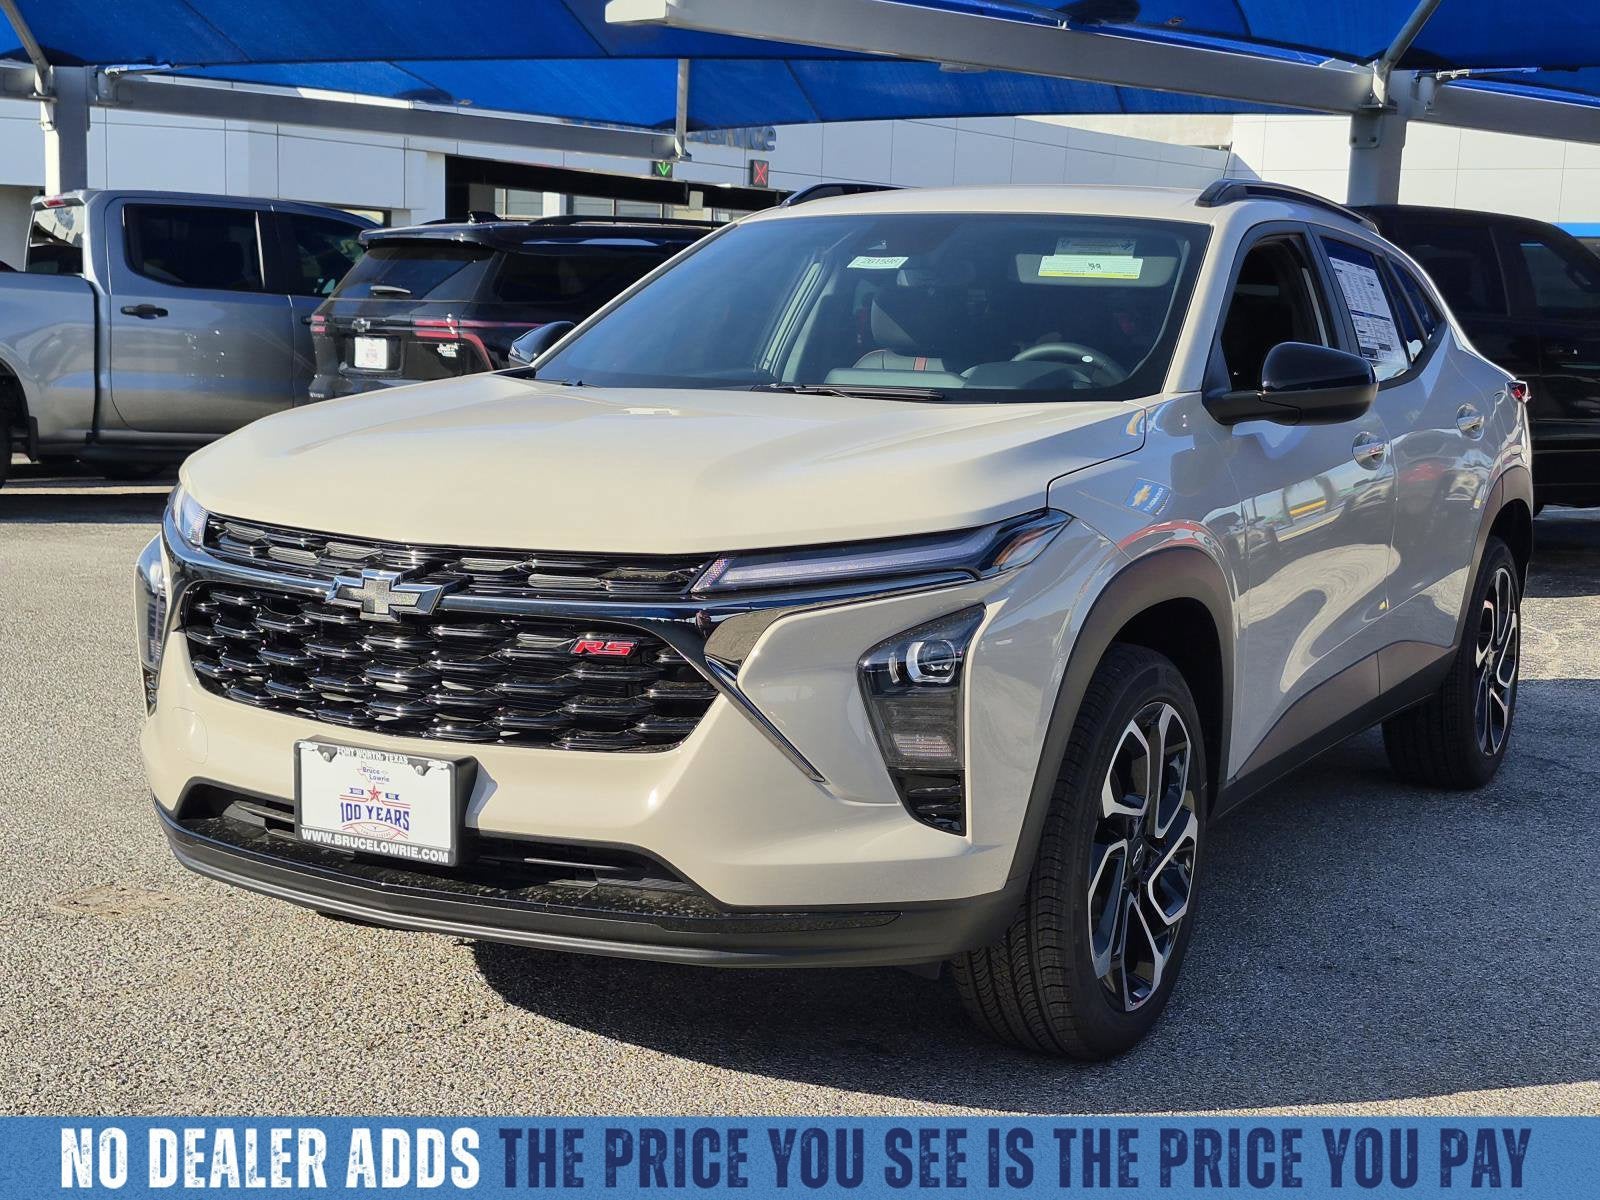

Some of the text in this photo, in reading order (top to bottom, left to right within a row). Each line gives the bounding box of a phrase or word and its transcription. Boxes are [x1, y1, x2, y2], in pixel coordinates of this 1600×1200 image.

[571, 640, 634, 655] RS
[362, 766, 380, 775] Bruce
[368, 774, 390, 782] Lowrie
[340, 802, 410, 831] 100 YEARS
[301, 828, 449, 864] WWW.BRUCELOWRIE.COM
